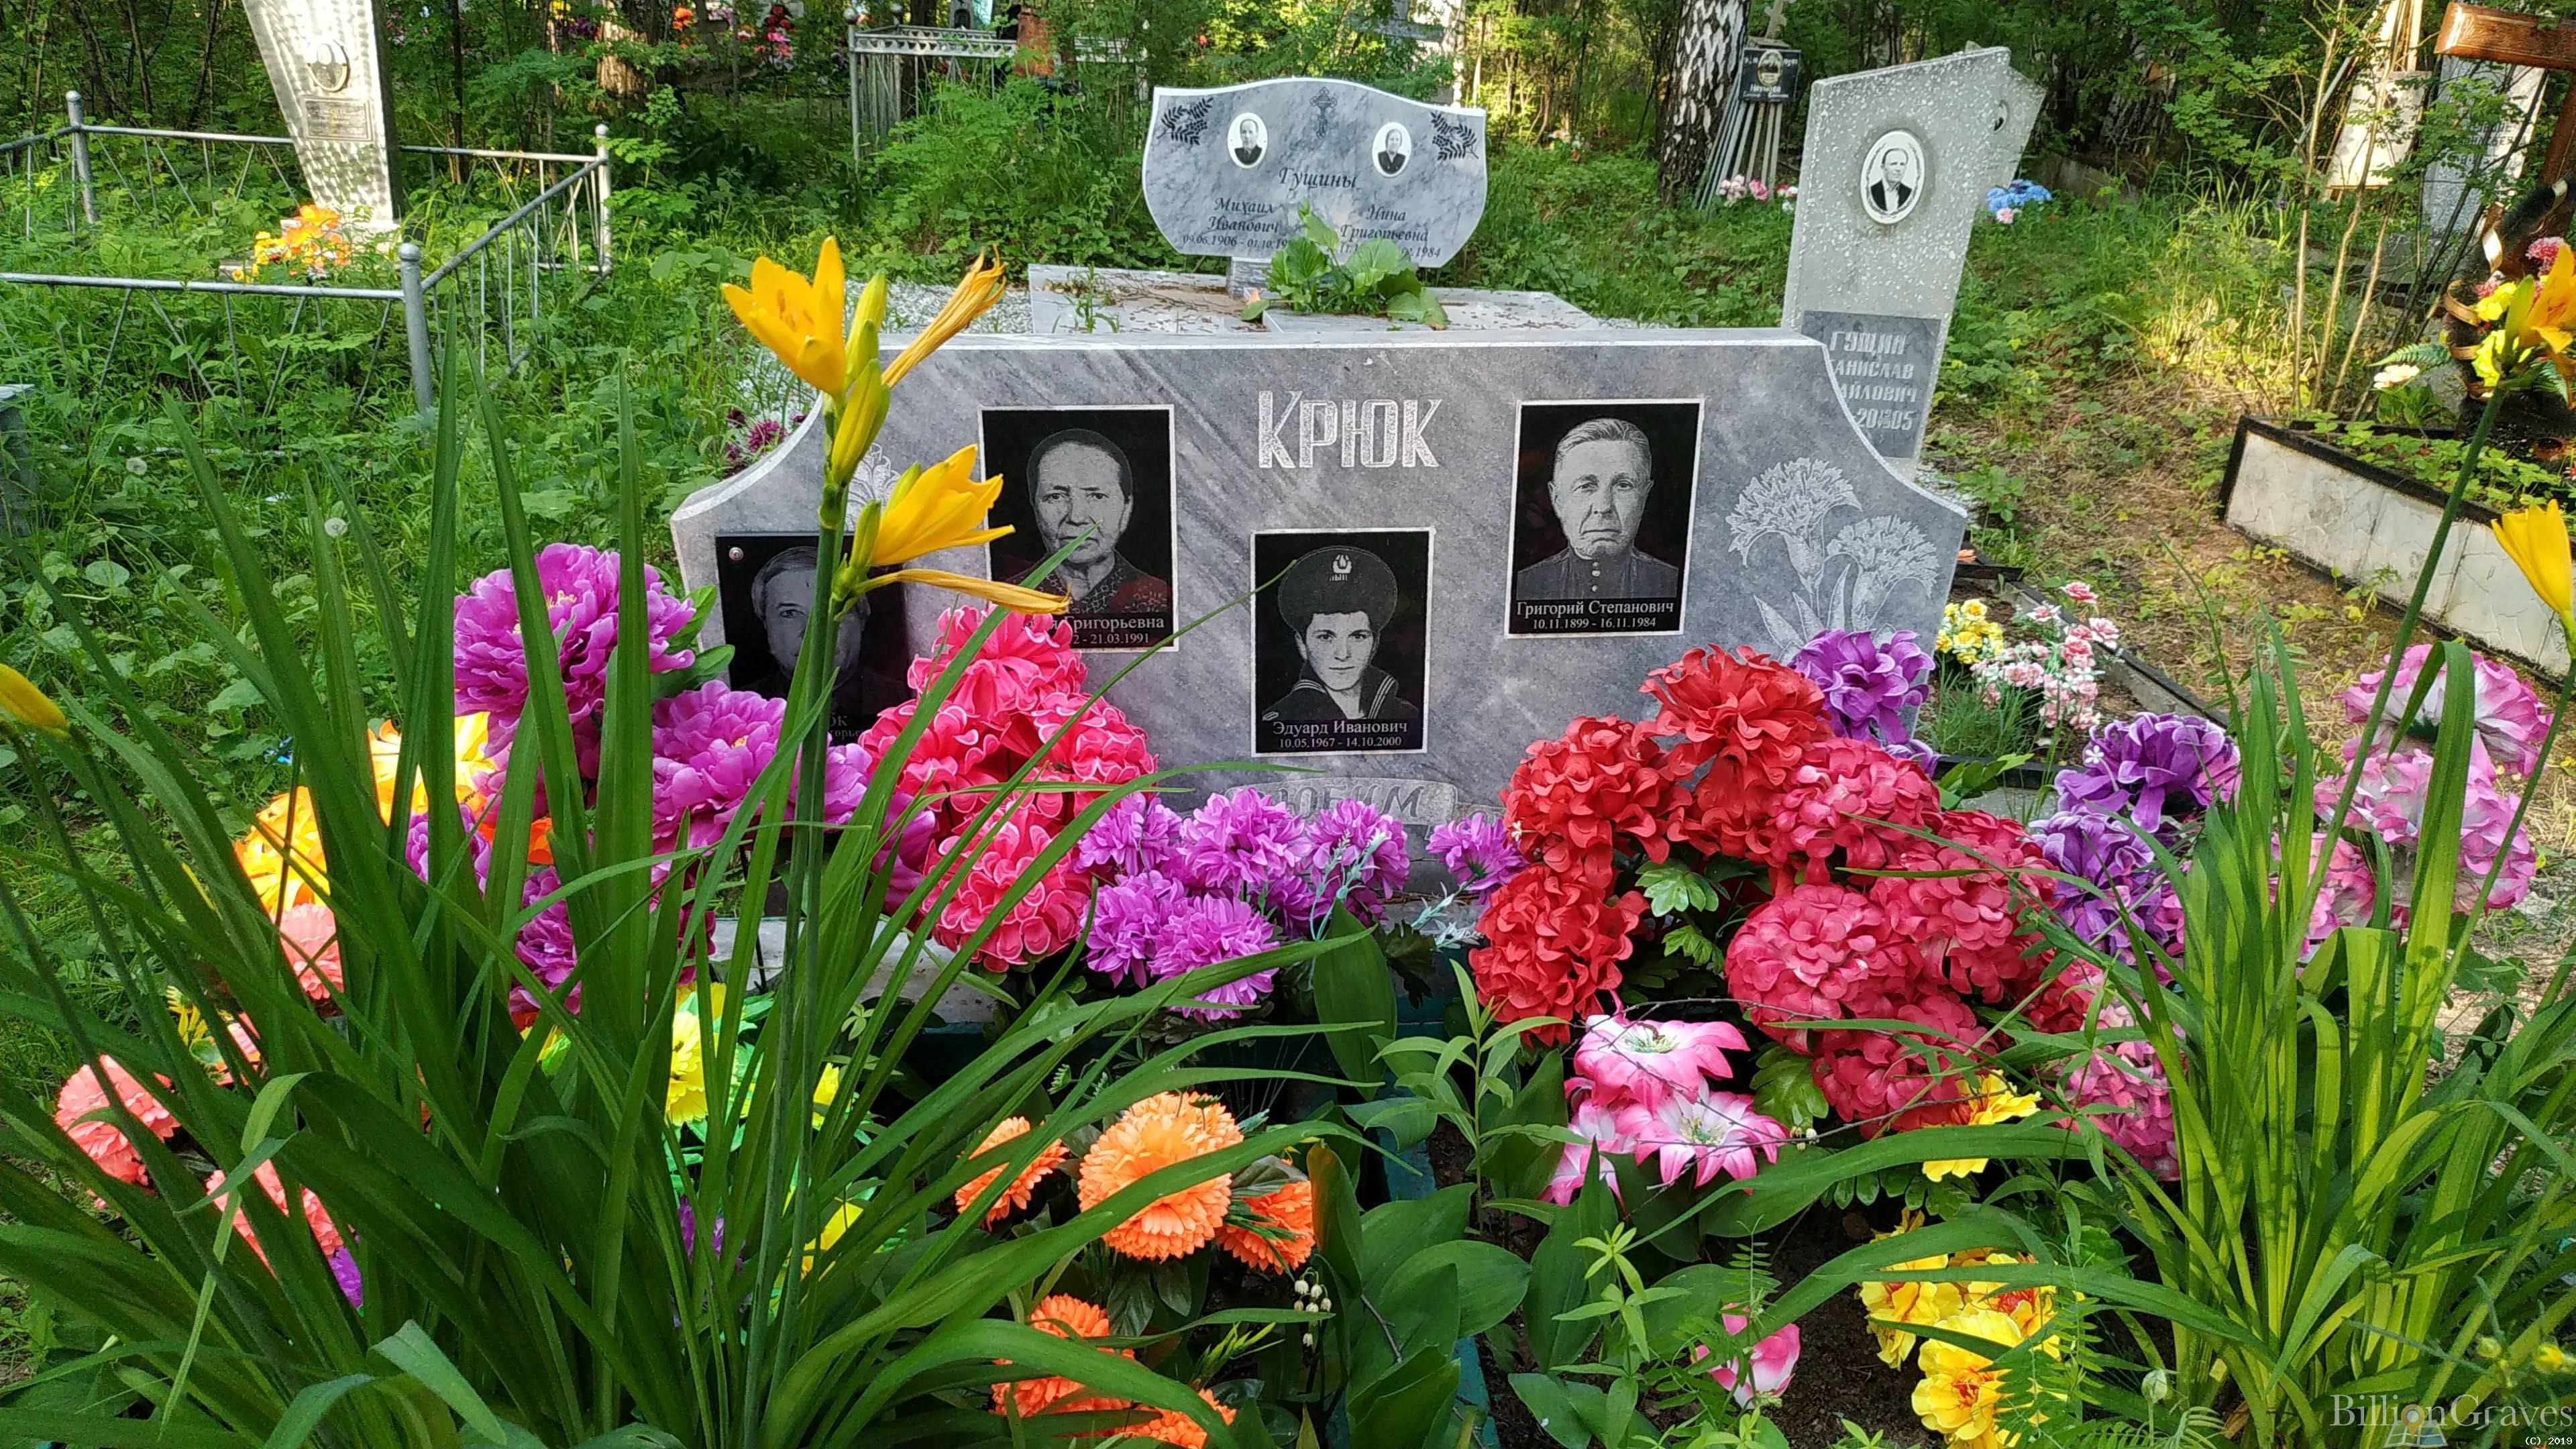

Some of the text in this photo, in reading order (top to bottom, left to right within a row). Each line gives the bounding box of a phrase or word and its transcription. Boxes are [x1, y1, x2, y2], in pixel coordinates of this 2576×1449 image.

[1279, 167, 1358, 191] Гущины
[1214, 197, 1273, 215] Михаил
[1366, 204, 1406, 221] Нина
[1207, 215, 1279, 233] Иванович
[1247, 239, 1288, 250] 01.10.19
[1829, 331, 1907, 356] ГУЩИН
[1831, 359, 1914, 380] АНИСЛАВ
[1840, 381, 1917, 402] АЙЛОВИЧ
[1258, 390, 1442, 468] КРЮК
[1517, 600, 1674, 619] Григорий Степанович
[1534, 618, 1589, 629] 10.11.1899
[1601, 617, 1656, 628] 16.11.1984
[1091, 633, 1149, 644] 21.03.1991
[1273, 720, 1407, 737] Эдуард Иванович
[1279, 737, 1335, 748] 10.05.1967
[1346, 737, 1402, 747] 14.10.2000
